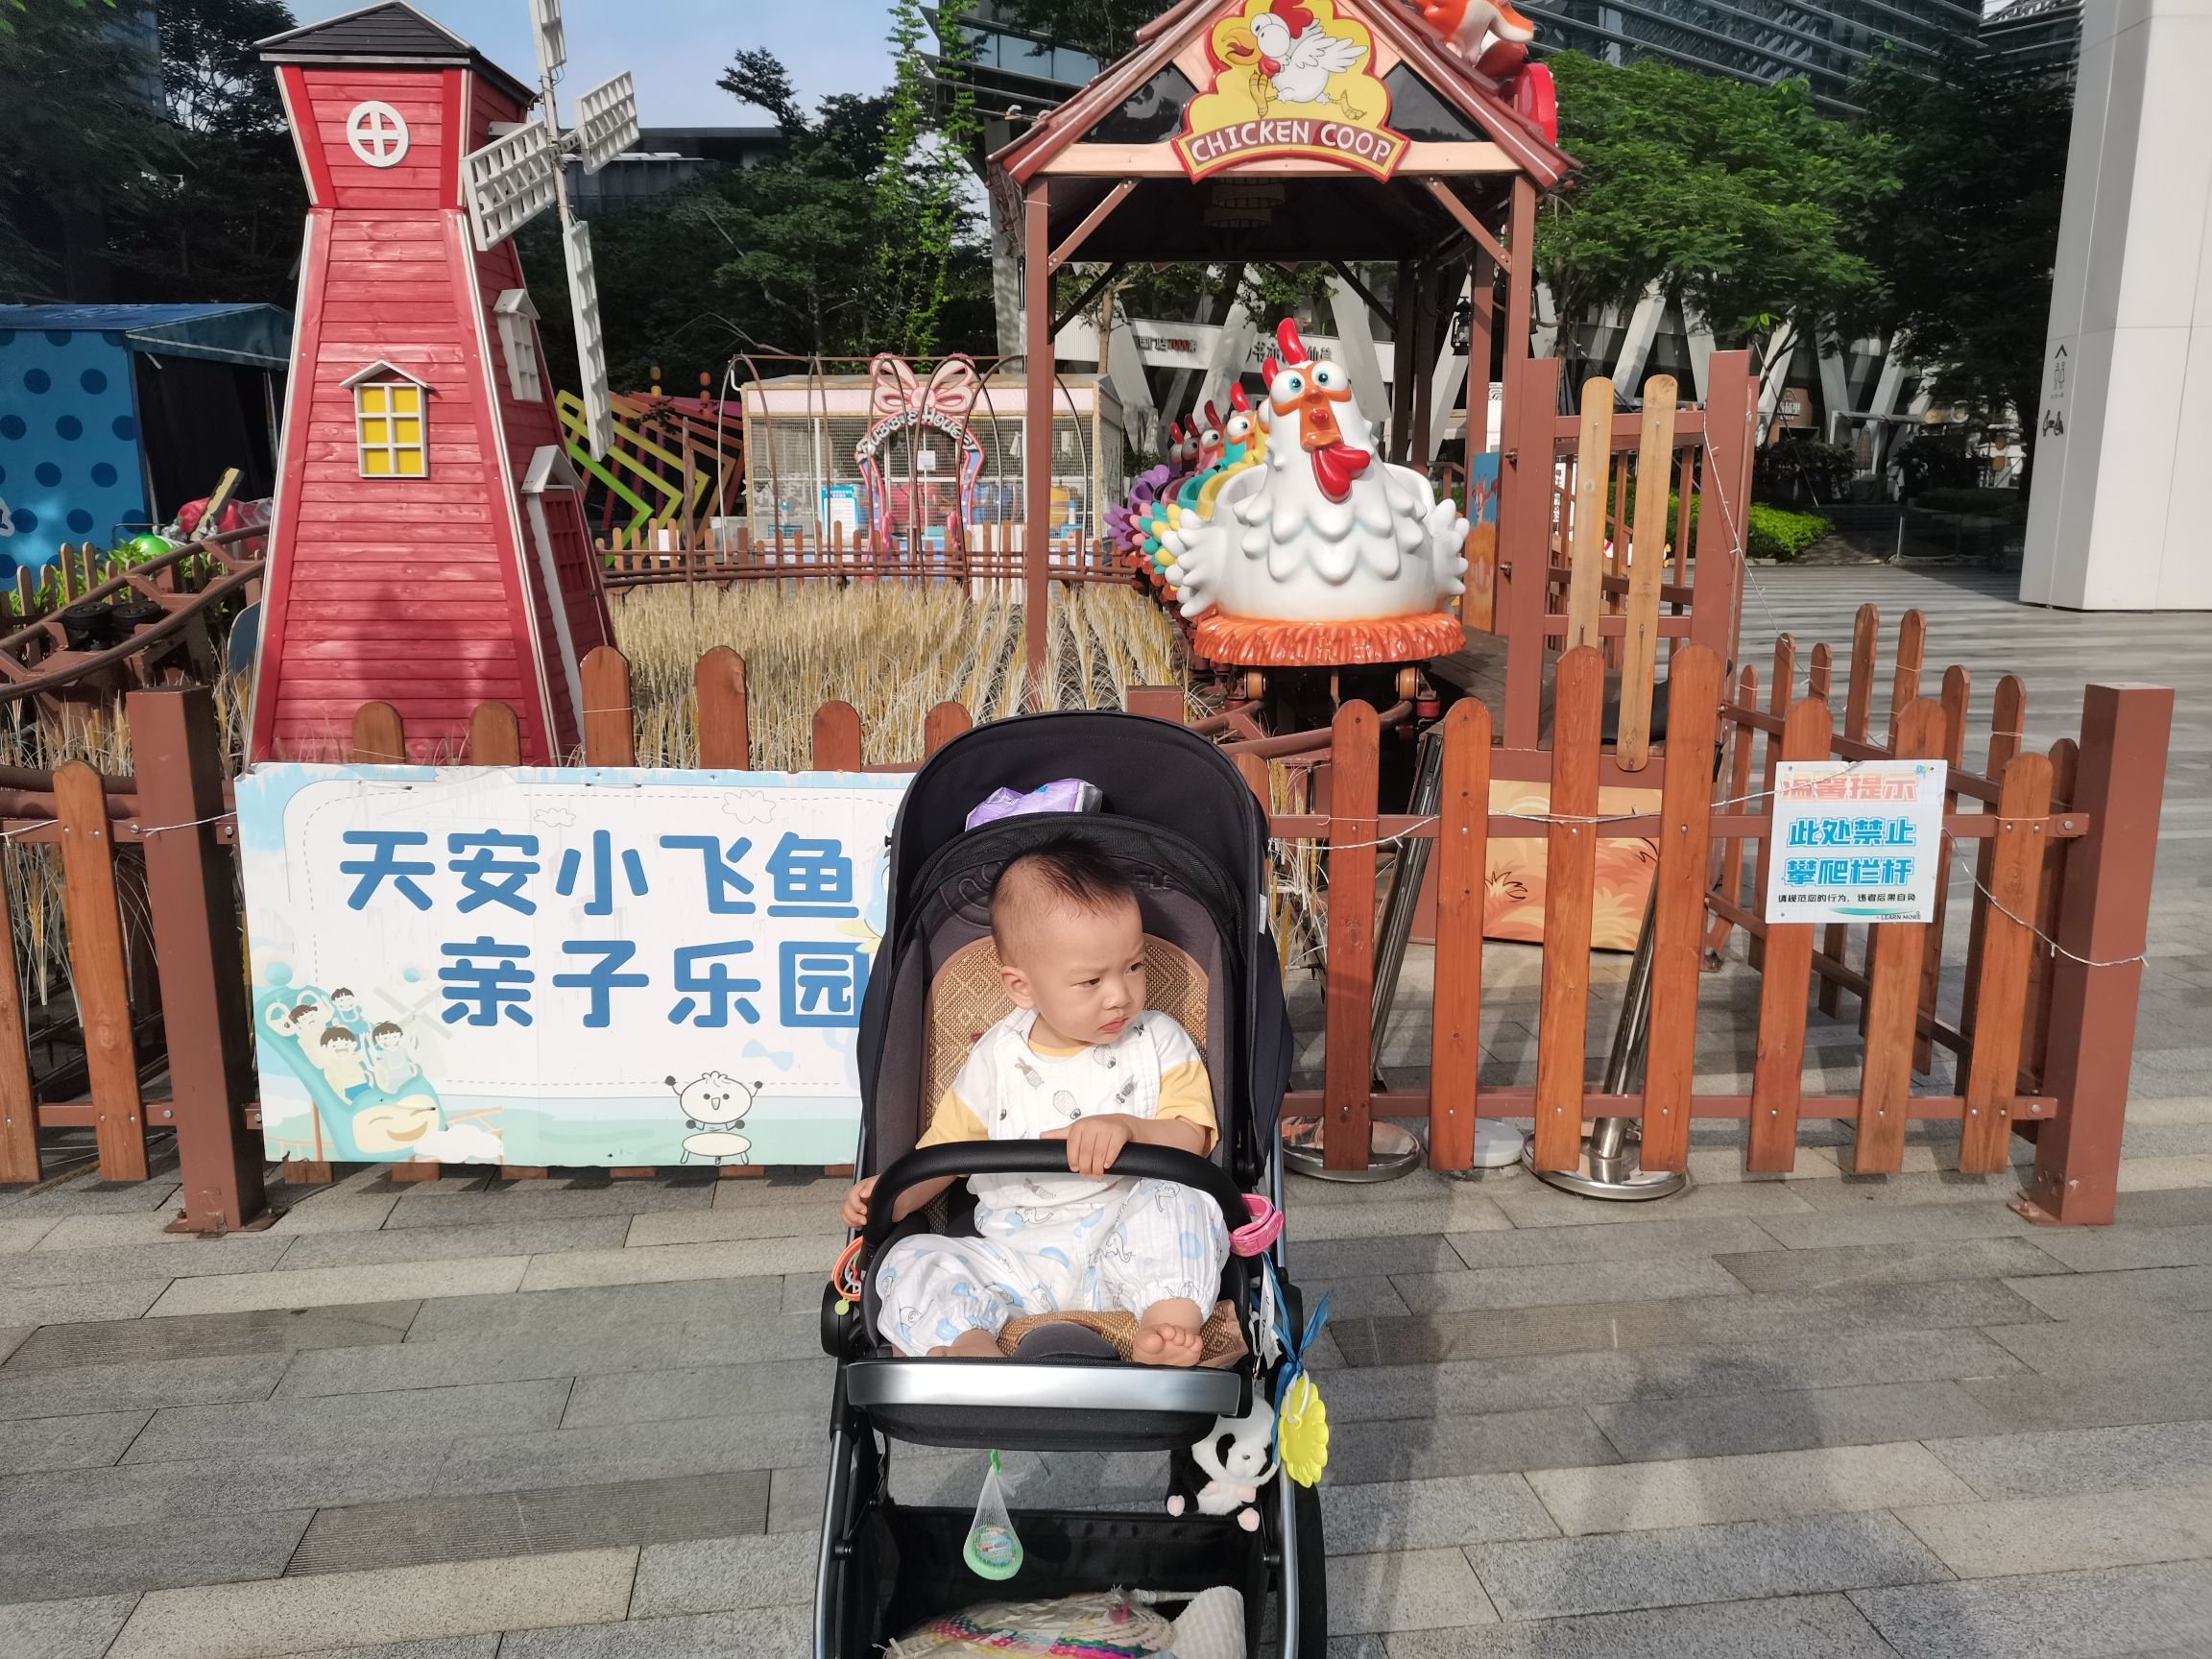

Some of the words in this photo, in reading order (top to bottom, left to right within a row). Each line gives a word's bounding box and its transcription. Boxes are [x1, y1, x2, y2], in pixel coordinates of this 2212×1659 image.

[1190, 120, 1310, 161] CHICKEN
[1320, 123, 1392, 161] COOP
[1780, 772, 1918, 802] 温馨提示
[1787, 817, 1916, 848] 此处禁止
[339, 829, 860, 920] 天安小飞鱼
[1784, 856, 1915, 887] 攀爬栏杆
[438, 935, 870, 1028] 亲子乐园
